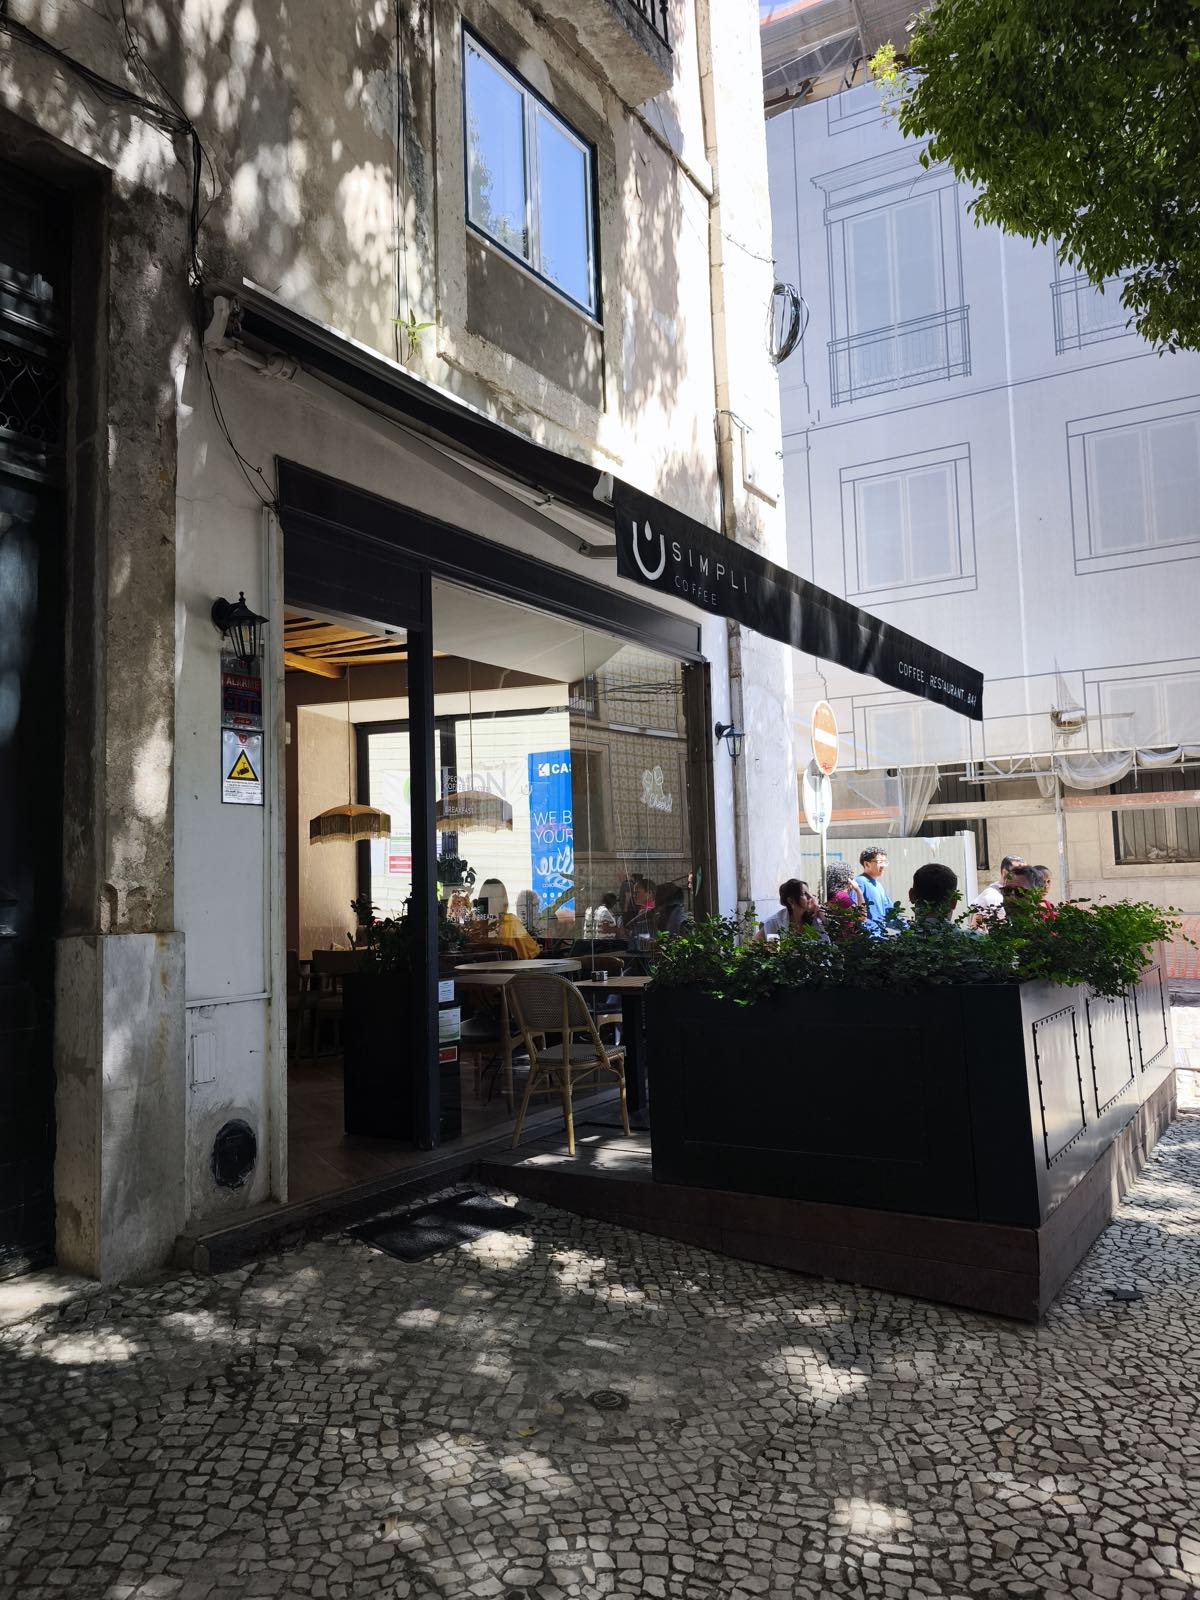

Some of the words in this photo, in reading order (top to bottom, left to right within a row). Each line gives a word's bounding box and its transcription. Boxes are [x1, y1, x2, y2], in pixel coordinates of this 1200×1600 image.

[671, 541, 748, 593] SIMPLI
[674, 575, 717, 606] COFFEE
[898, 661, 925, 683] COFFEE
[929, 675, 965, 700] RESTAURANT
[533, 810, 557, 826] WE
[534, 828, 574, 845] YOUR
[446, 853, 465, 861] LUNH
[446, 914, 471, 923] PASTES
